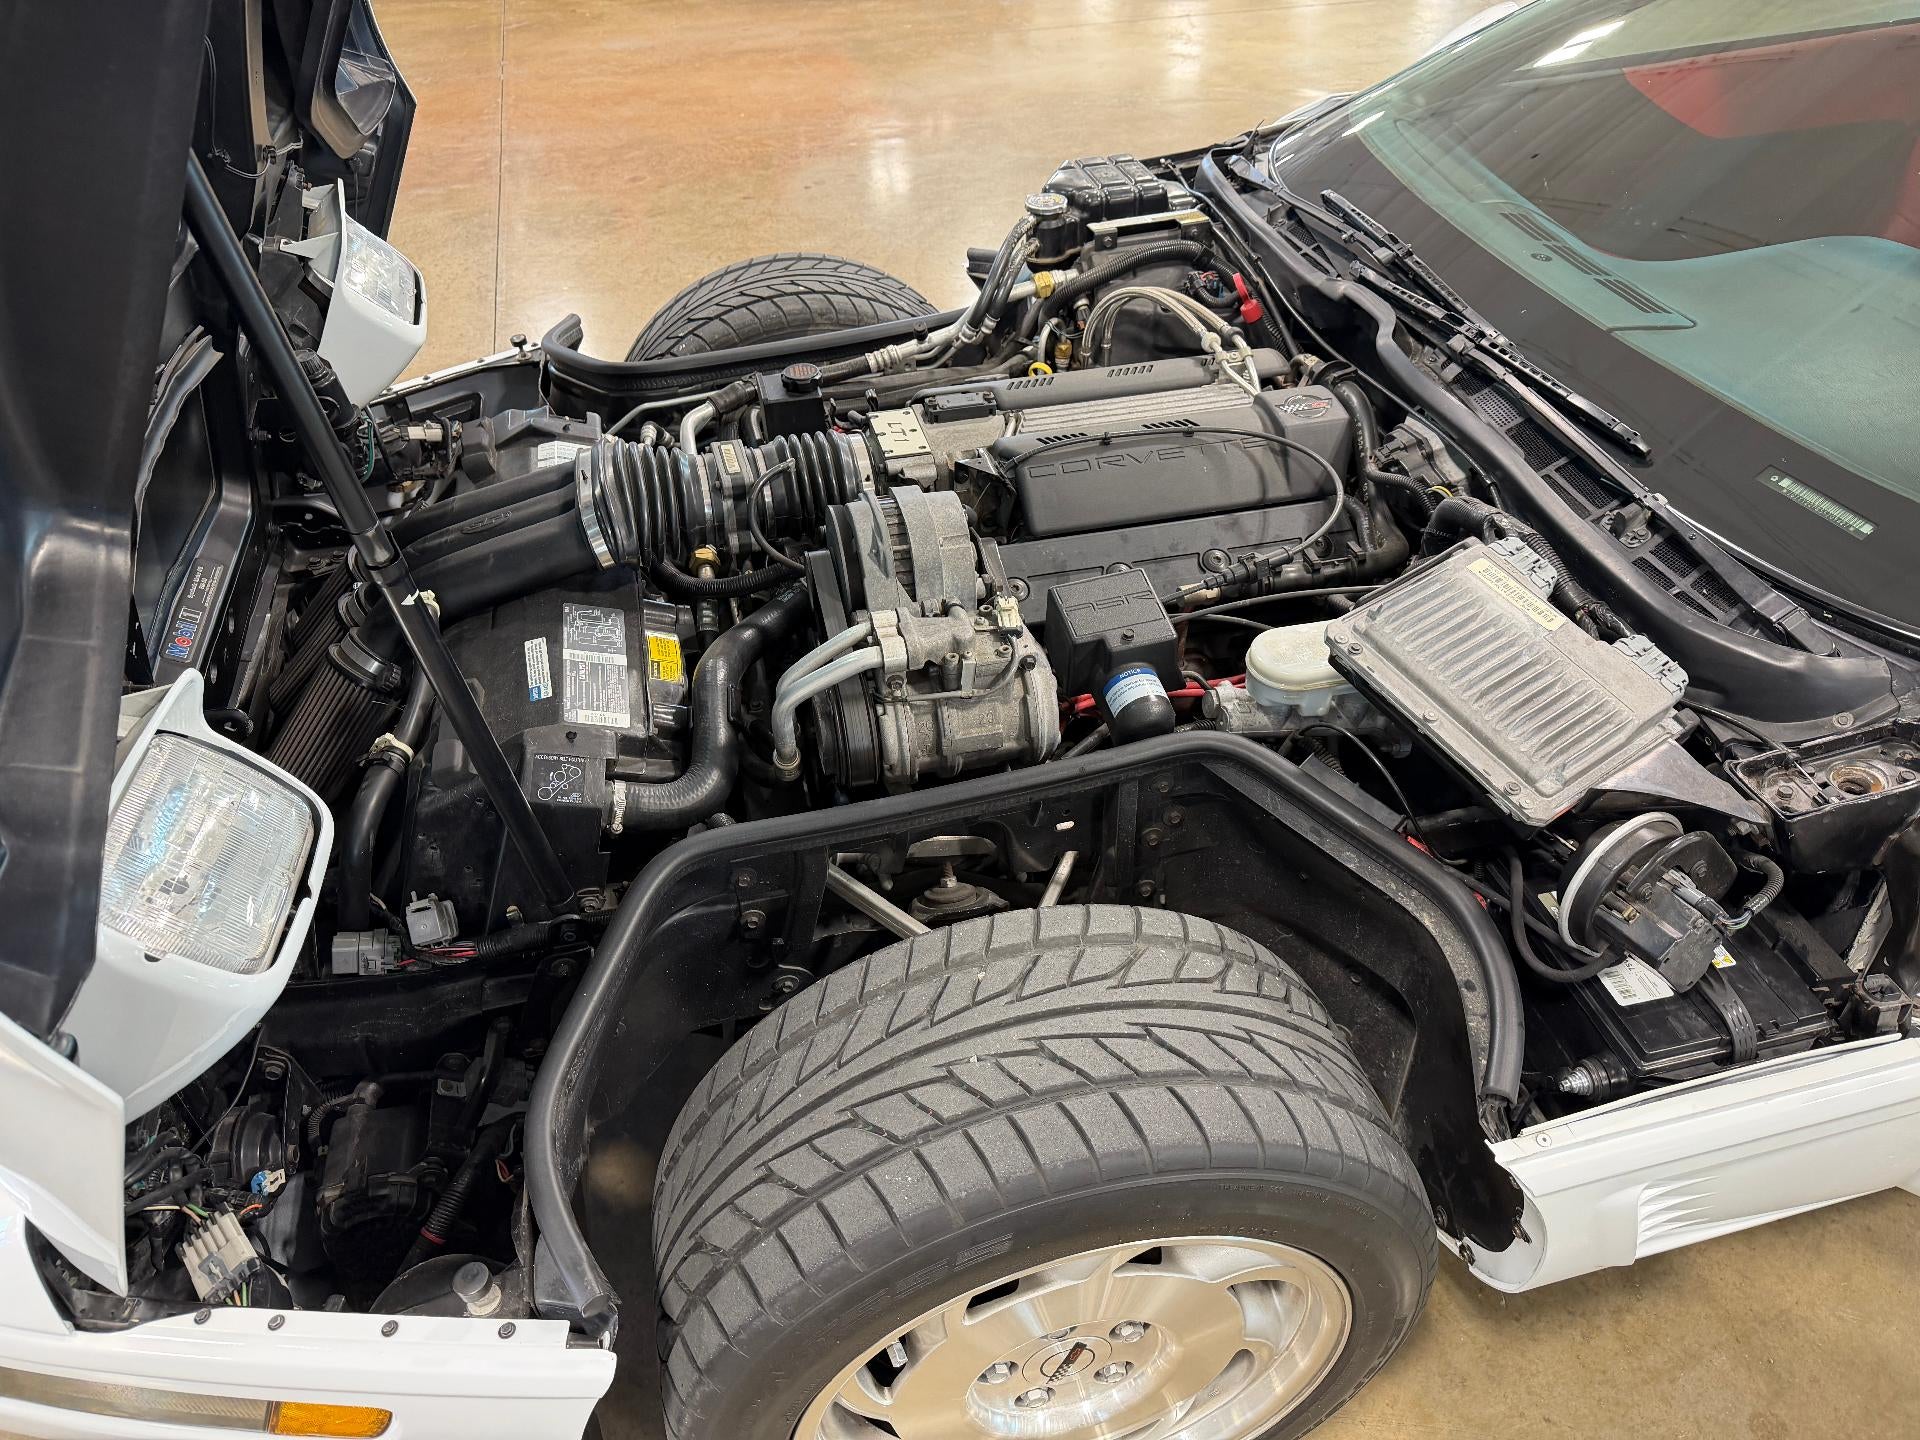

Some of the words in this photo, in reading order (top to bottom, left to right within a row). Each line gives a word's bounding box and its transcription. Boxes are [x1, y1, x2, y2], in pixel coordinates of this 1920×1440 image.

[887, 422, 909, 442] LT1
[1027, 436, 1268, 479] CORVETTE
[166, 621, 198, 659] Mobil
[1119, 668, 1141, 679] NOTICE
